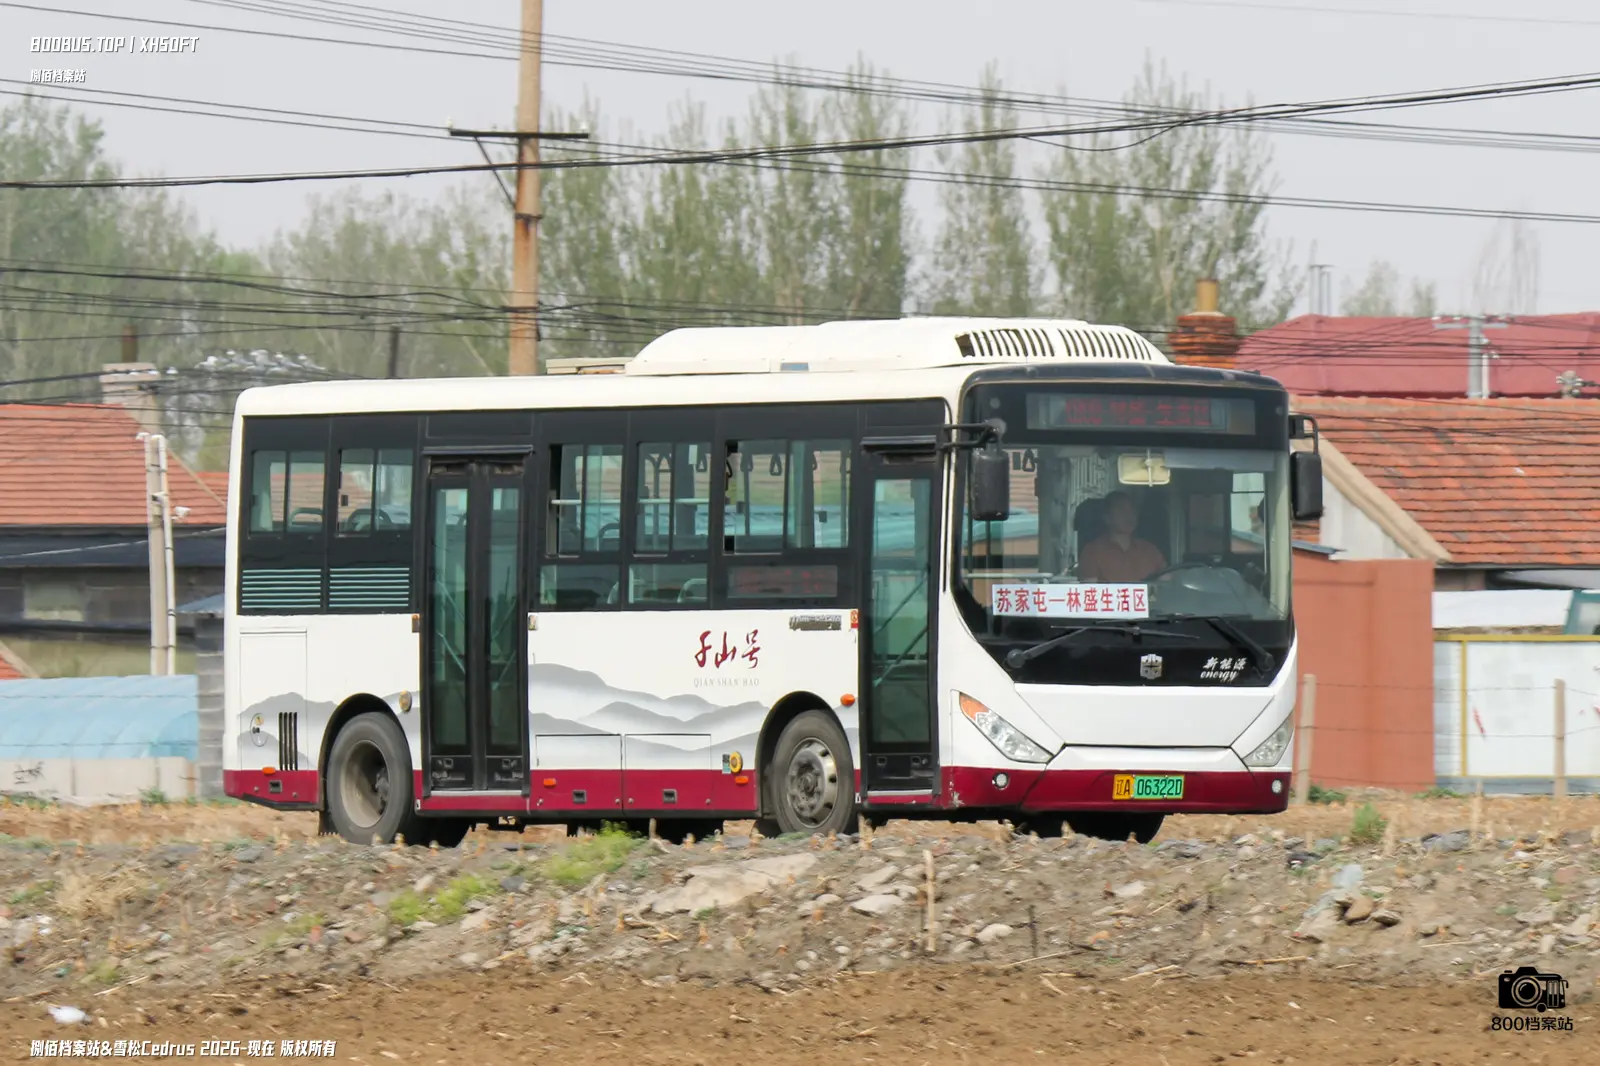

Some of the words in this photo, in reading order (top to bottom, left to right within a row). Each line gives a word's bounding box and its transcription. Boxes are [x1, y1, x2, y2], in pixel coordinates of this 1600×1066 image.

[694, 629, 761, 669] 千山号
[1203, 656, 1248, 671] 新能源
[693, 677, 714, 688] QIAN
[717, 677, 739, 687] SHAN
[742, 677, 760, 687] HAO
[1200, 669, 1239, 683] energy
